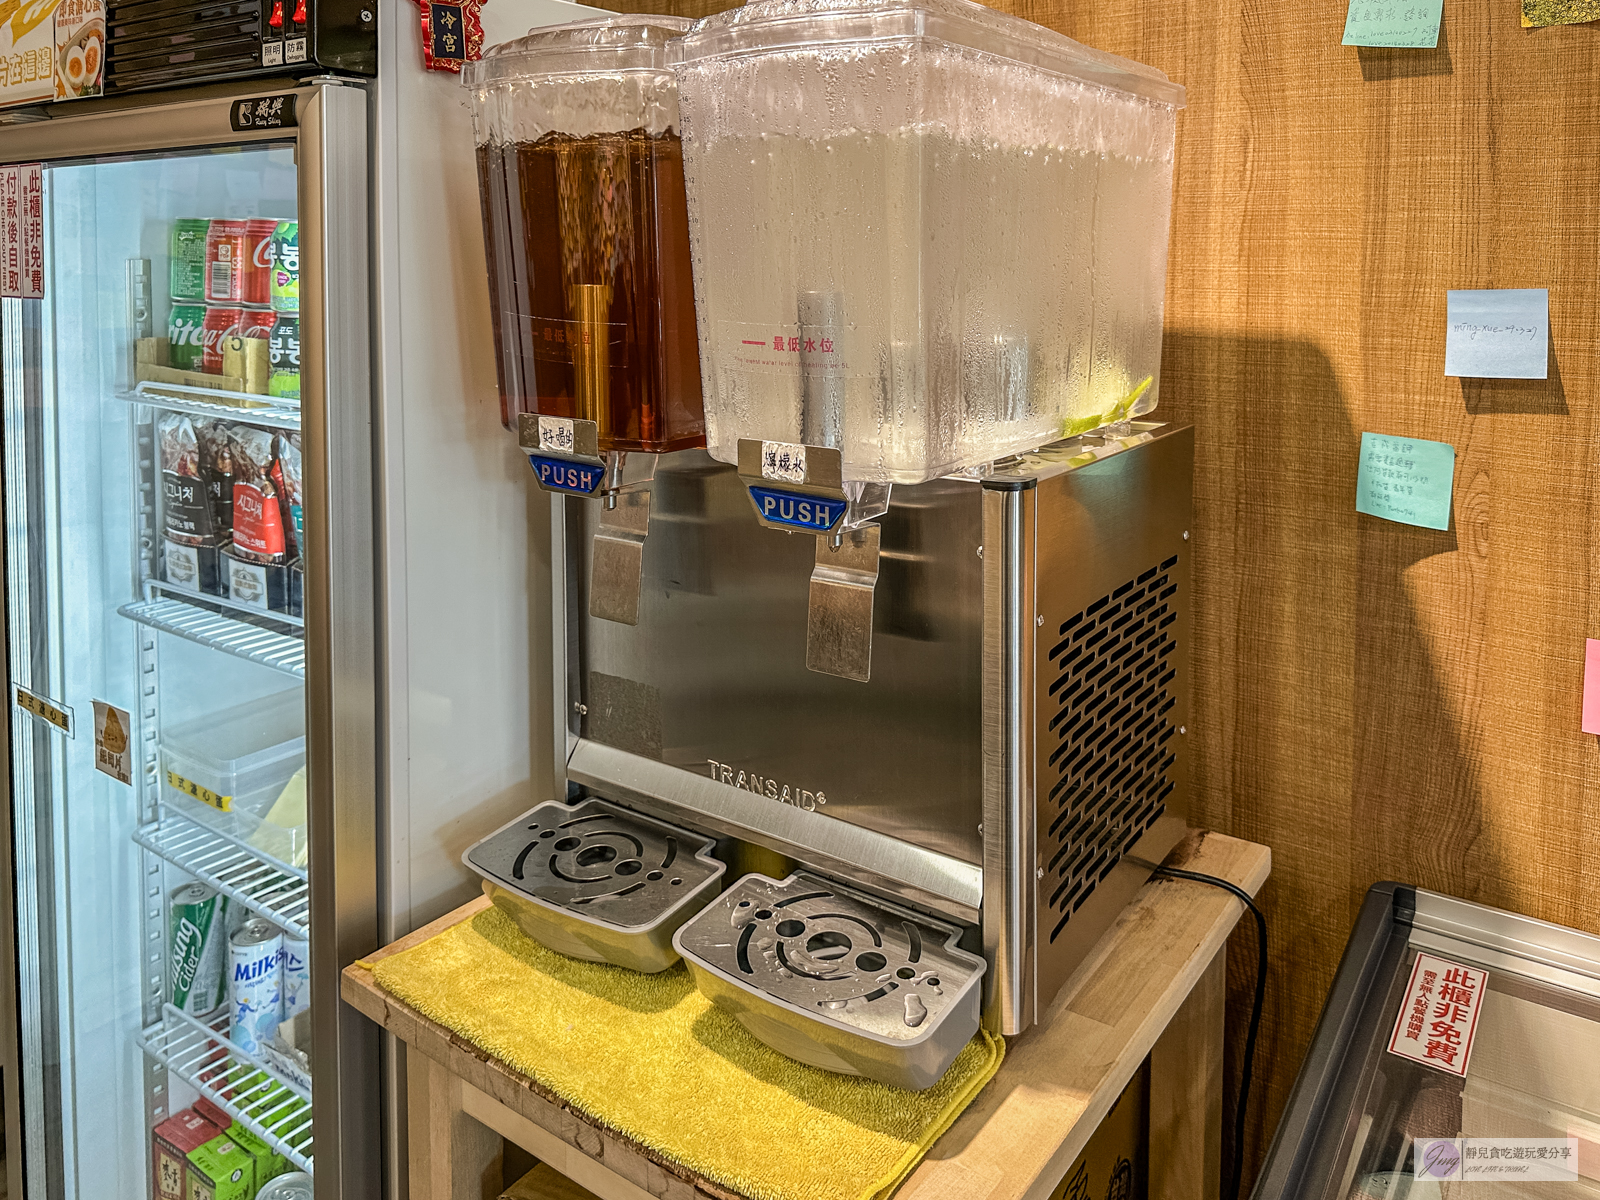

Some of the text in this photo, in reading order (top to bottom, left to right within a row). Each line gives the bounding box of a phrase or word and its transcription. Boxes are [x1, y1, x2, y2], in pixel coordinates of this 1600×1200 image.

[287, 41, 304, 53] 防霧
[441, 11, 457, 53] 冷宮
[264, 44, 280, 57] 照明
[6, 171, 19, 293] 付款後自取
[29, 169, 42, 293] 此櫃非免費
[773, 336, 834, 353] 最低水位
[541, 464, 593, 491] PUSH
[764, 496, 830, 527] PUSH
[179, 945, 199, 992] Cider
[1422, 968, 1476, 1067] 此櫃非免費
